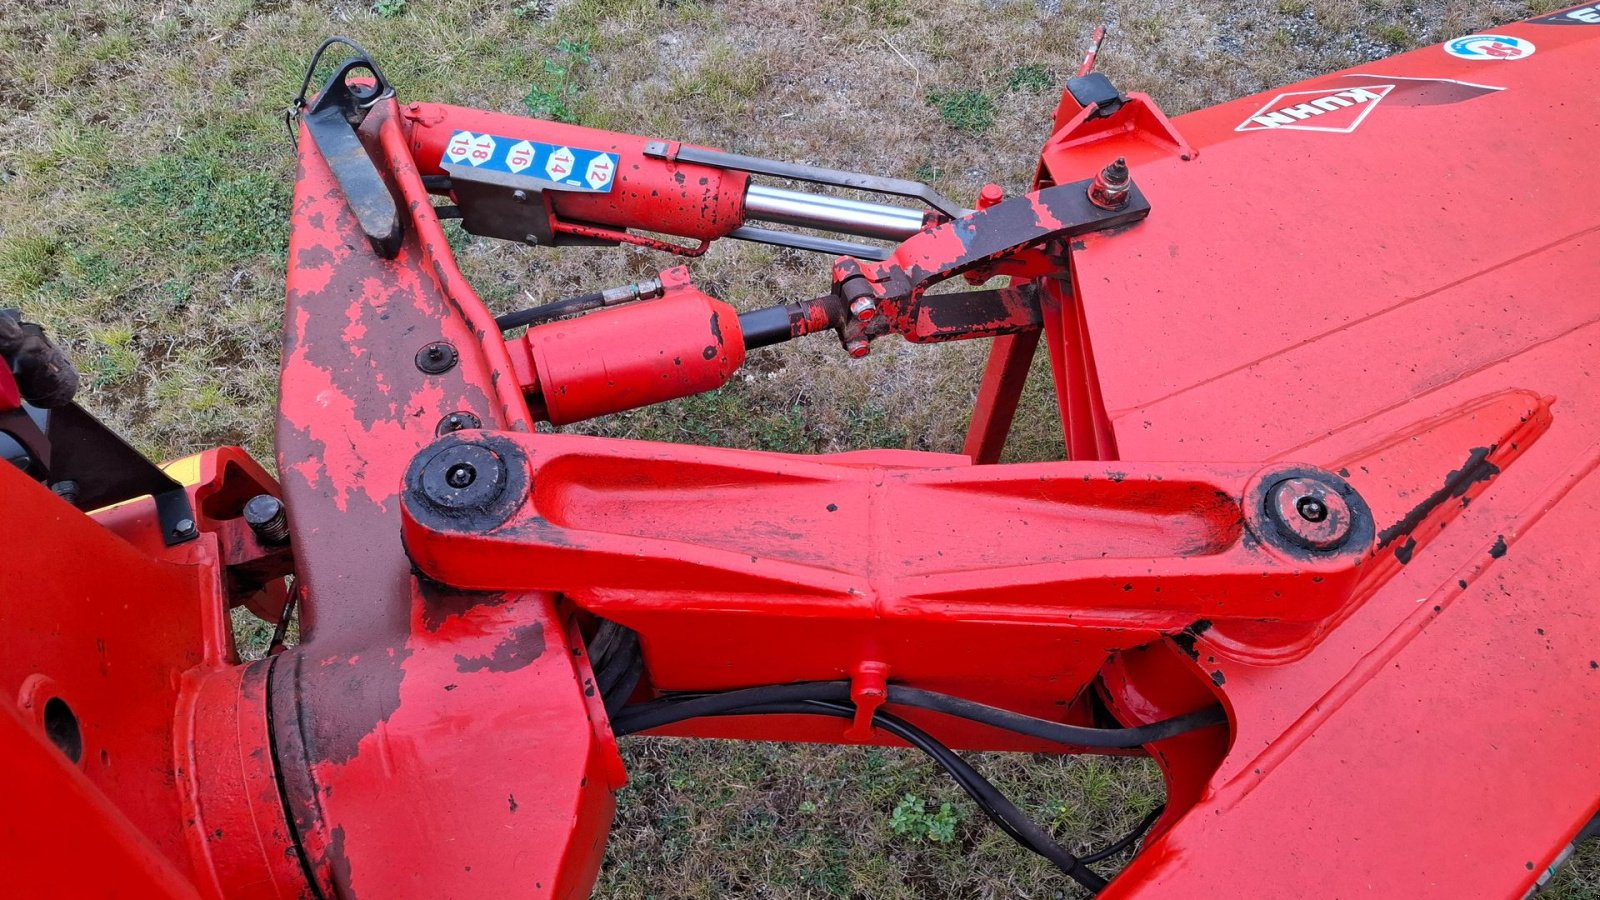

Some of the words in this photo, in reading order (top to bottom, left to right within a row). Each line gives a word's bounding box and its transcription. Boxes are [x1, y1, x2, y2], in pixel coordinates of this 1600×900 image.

[1251, 87, 1382, 128] KUHN
[450, 138, 470, 157] 19
[471, 141, 491, 160] 18
[511, 149, 531, 167] 16
[551, 156, 570, 174] 14
[590, 162, 609, 182] 12
